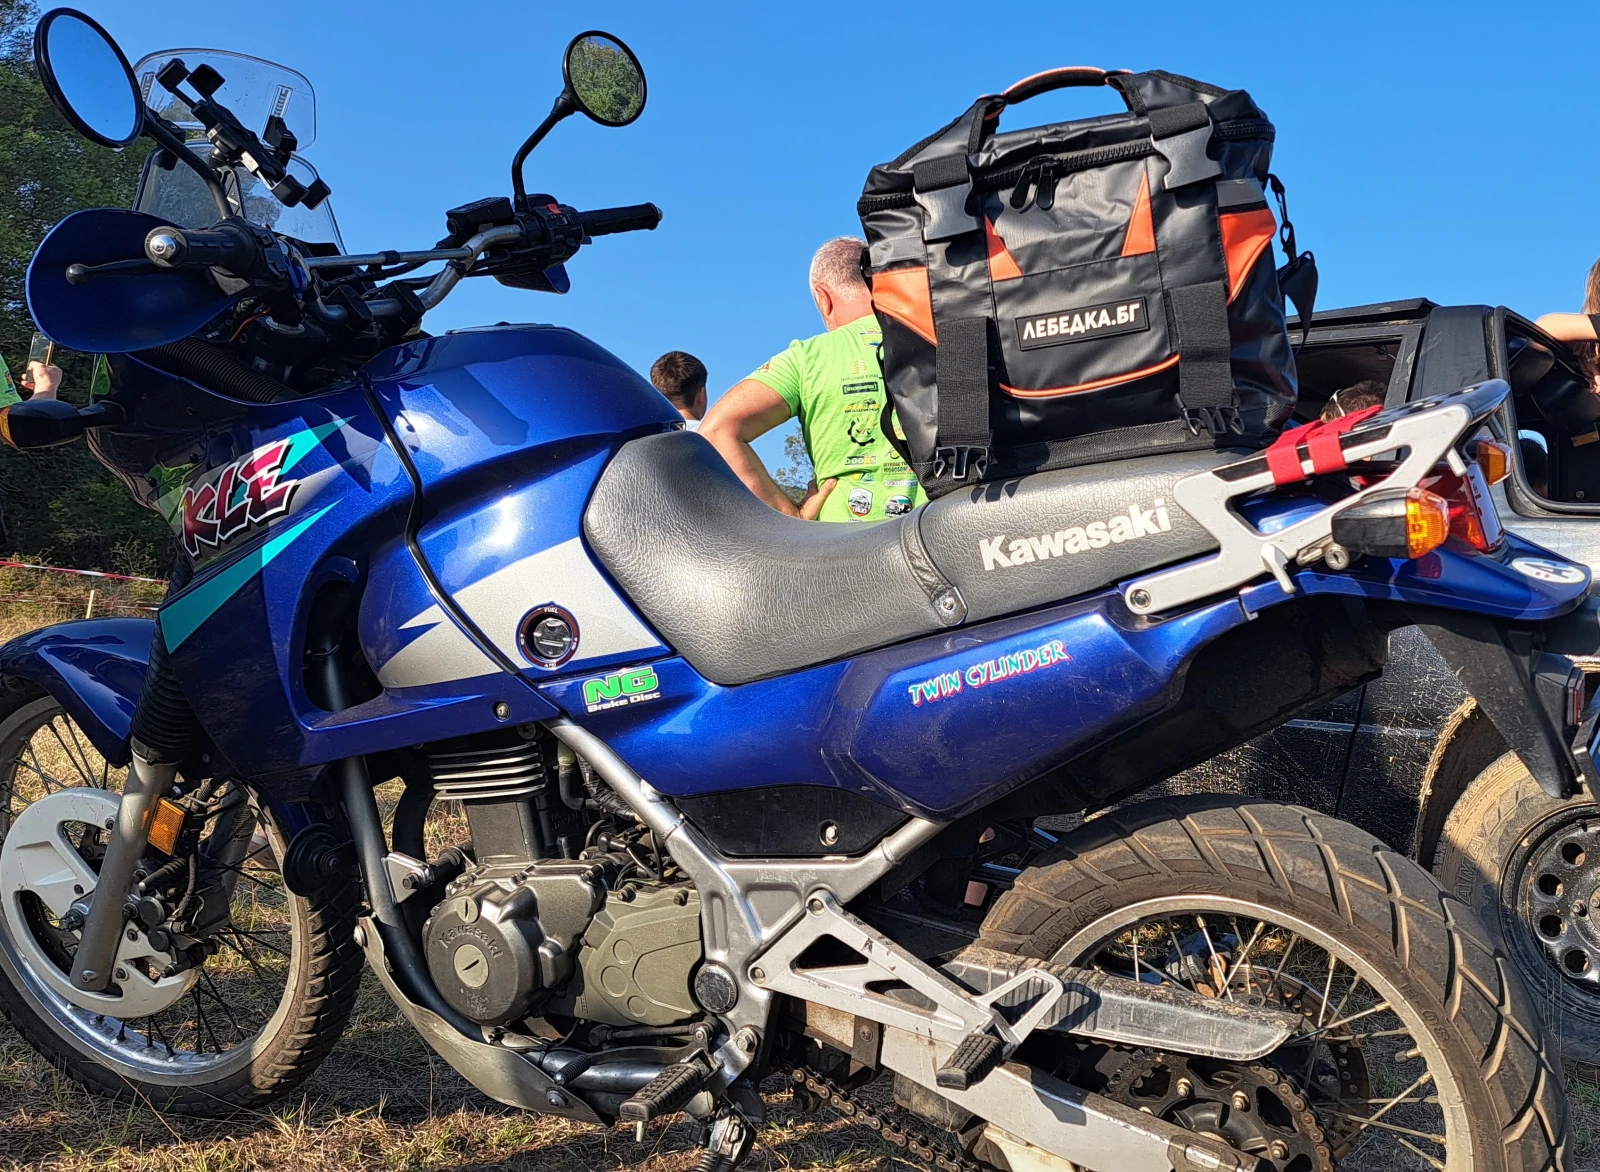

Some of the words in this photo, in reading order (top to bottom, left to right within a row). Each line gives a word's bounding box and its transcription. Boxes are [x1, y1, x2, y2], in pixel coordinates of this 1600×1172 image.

[1022, 303, 1140, 340] ЛЕБЕДКА.БГ
[178, 438, 300, 560] KLE
[979, 498, 1172, 571] Kawasaki
[583, 666, 659, 705] NG
[908, 671, 963, 706] TWIN
[965, 640, 1073, 688] CYLINDER
[587, 698, 628, 713] Brake
[630, 691, 661, 704] Disc
[438, 924, 504, 960] Kawasaki
[1032, 894, 1113, 956] MITAS
